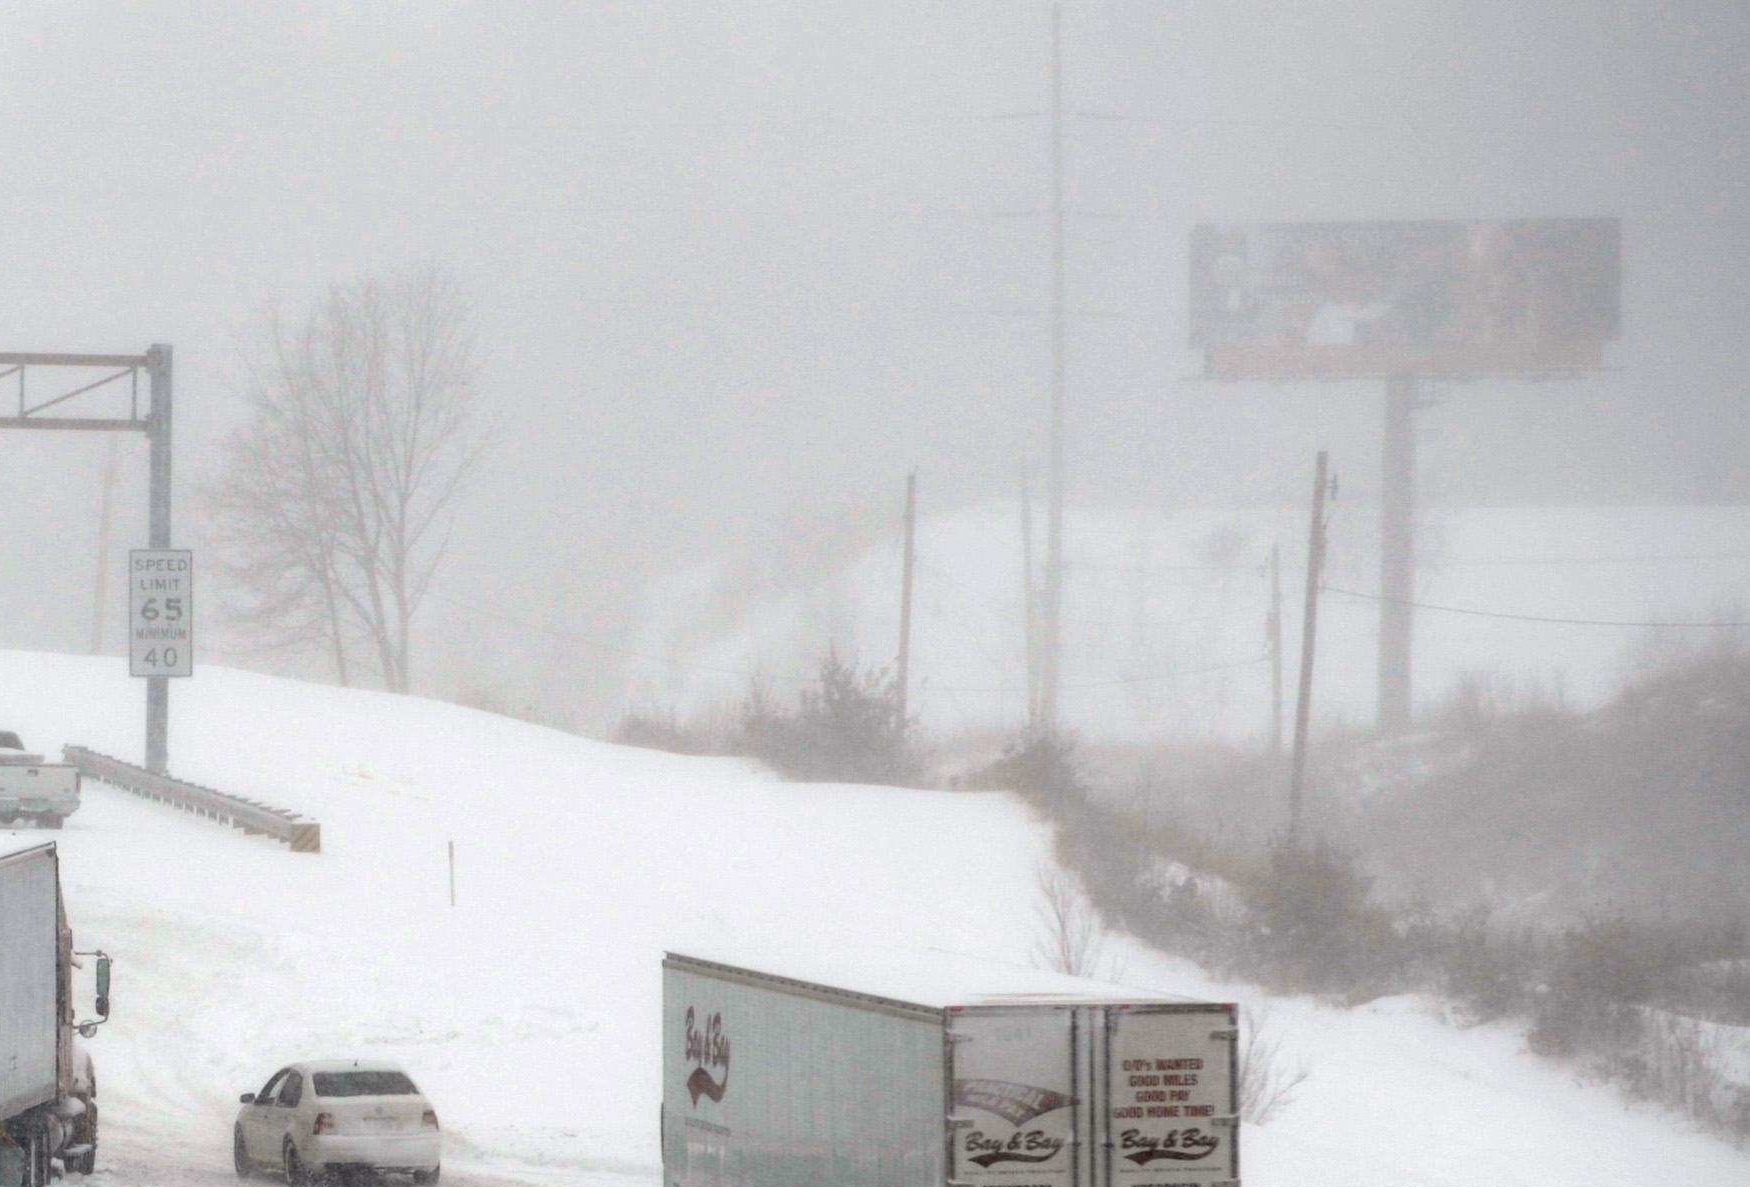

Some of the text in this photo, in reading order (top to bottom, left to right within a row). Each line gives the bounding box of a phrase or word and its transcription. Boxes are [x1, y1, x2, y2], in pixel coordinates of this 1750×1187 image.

[133, 559, 188, 572] SPEED
[139, 579, 181, 591] LIMIT
[140, 597, 183, 622] 65
[135, 627, 188, 641] MINIMUM
[143, 647, 178, 668] 40
[1128, 1074, 1199, 1087] GOOD MILES
[1135, 1090, 1191, 1102] GOOD PAY
[1113, 1106, 1144, 1118] GOOD
[1147, 1105, 1180, 1117] HOME
[965, 1130, 1003, 1152] Bay
[1024, 1129, 1065, 1151] Bay
[1120, 1128, 1161, 1150] Bay
[1180, 1127, 1221, 1149] Bay
